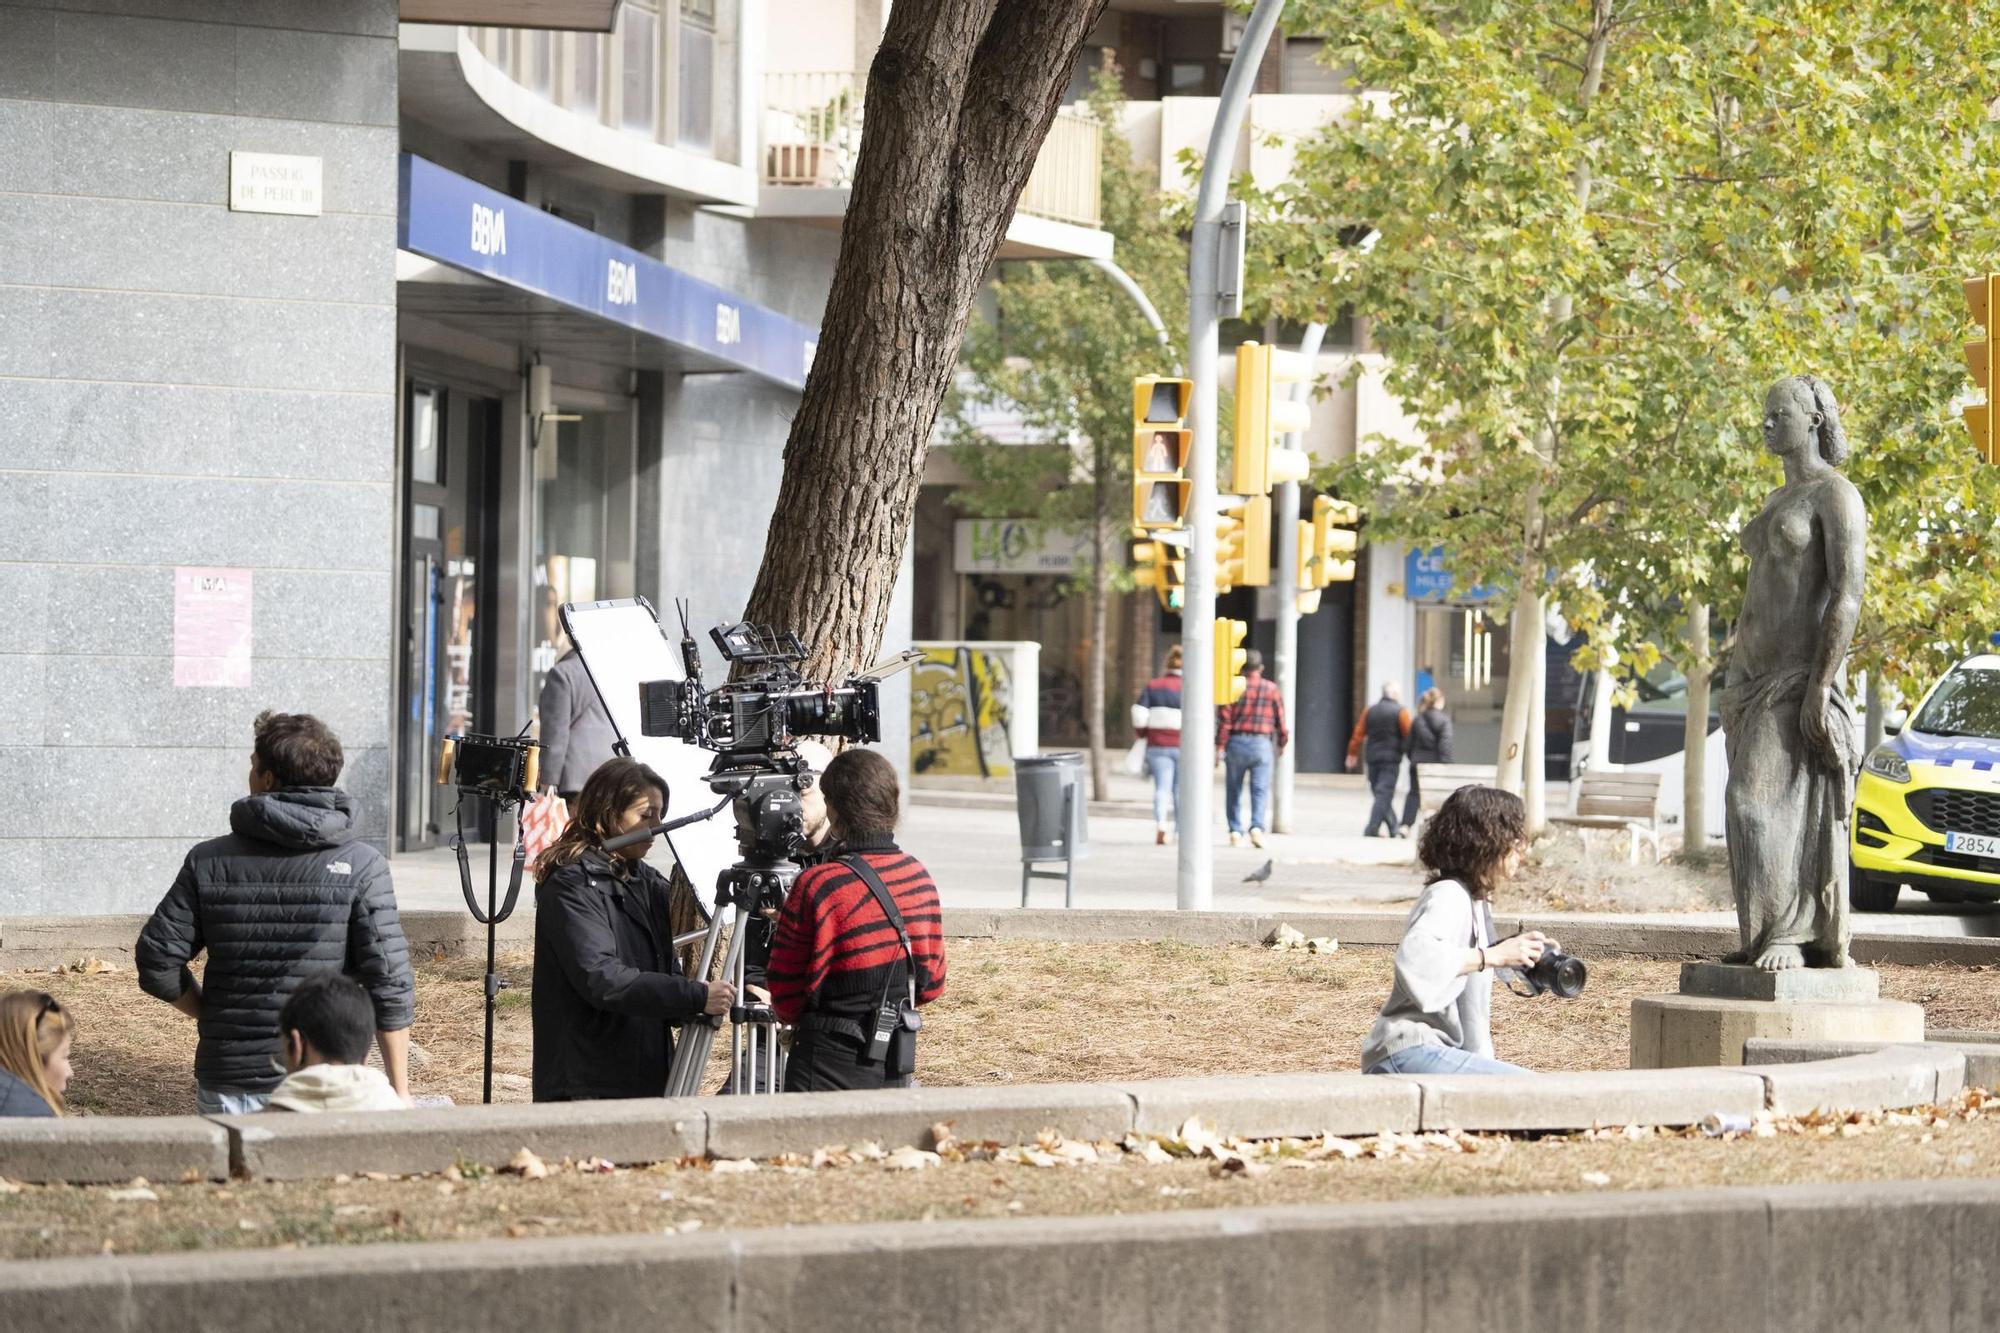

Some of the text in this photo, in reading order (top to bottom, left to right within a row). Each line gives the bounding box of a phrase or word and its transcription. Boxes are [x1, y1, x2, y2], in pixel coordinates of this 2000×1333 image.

[251, 165, 304, 180] PASSEIG
[240, 184, 313, 203] DE PERE III
[471, 203, 507, 256] BBVA
[607, 259, 637, 306] BBVA
[716, 303, 740, 344] BBVA
[1956, 836, 1995, 855] 2854
